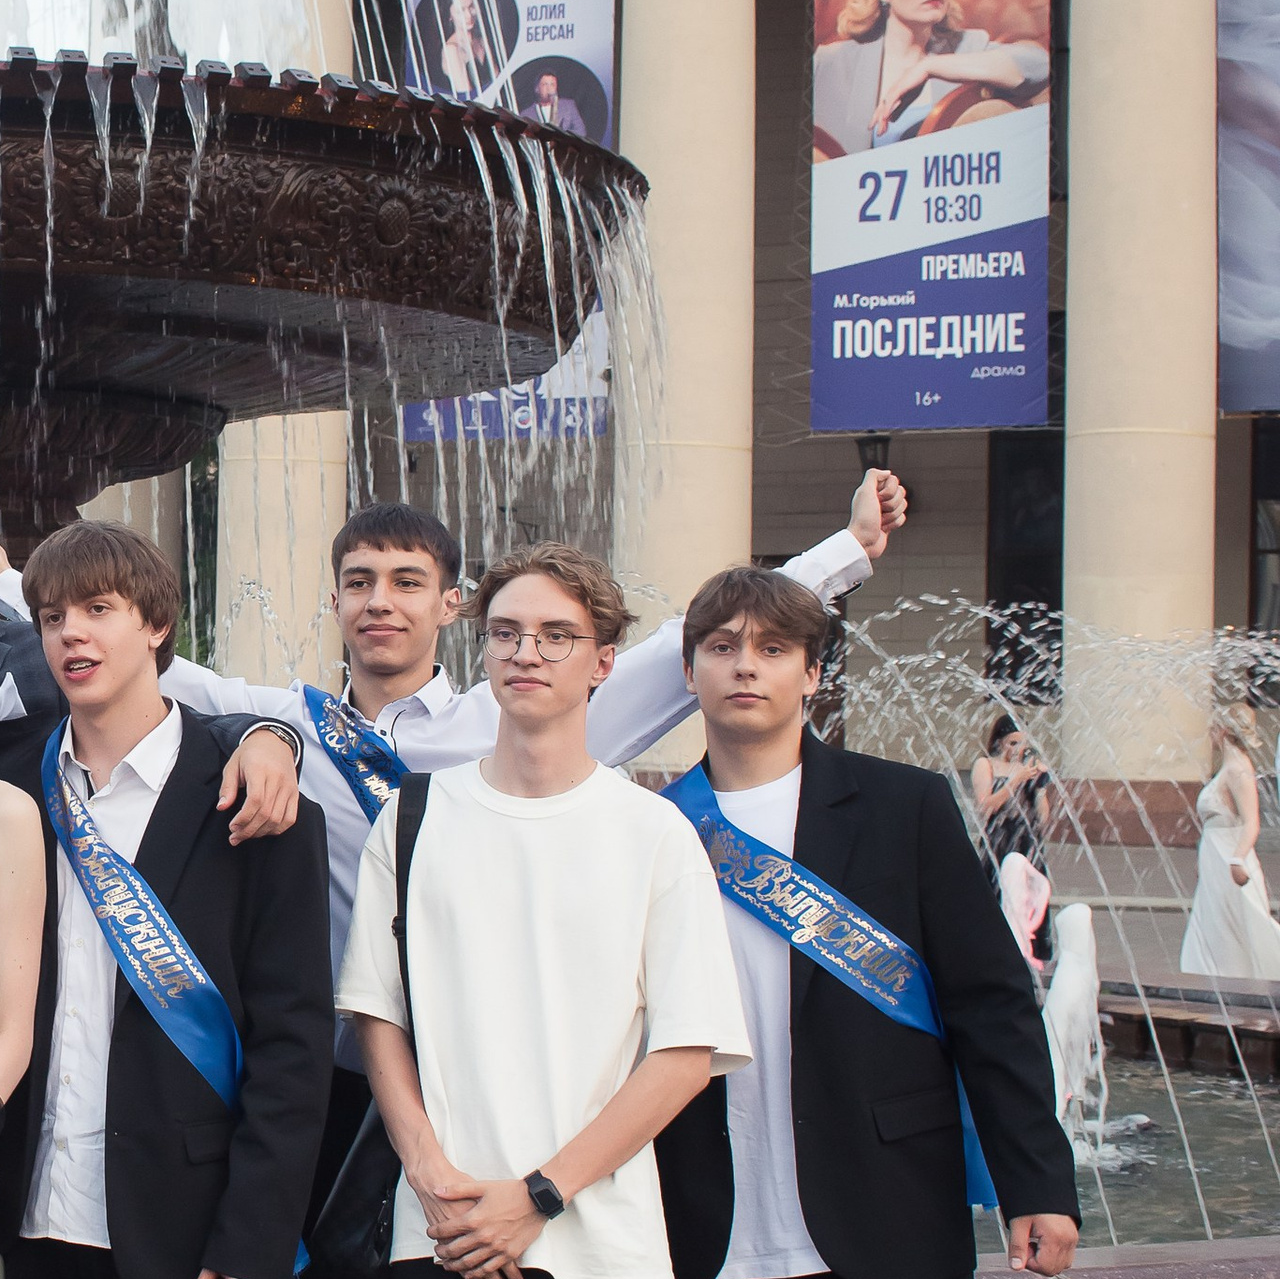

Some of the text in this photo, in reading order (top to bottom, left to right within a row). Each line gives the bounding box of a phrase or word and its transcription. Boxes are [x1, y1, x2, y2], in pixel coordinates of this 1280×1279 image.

[526, 3, 565, 21] ЮЛИЯ
[526, 23, 574, 42] БЕРСАН
[858, 151, 1001, 222] 27 ИЮНЯ
[923, 193, 981, 224] 18:30
[922, 251, 1026, 281] ПРЕМЬЕРА
[833, 290, 916, 311] М.Горький
[833, 312, 1026, 359] ПОСЛЕДНИЕ
[971, 365, 1026, 380] драма
[915, 391, 942, 407] 16+
[71, 823, 196, 999] Выпускник
[734, 854, 914, 993] Выпускник
